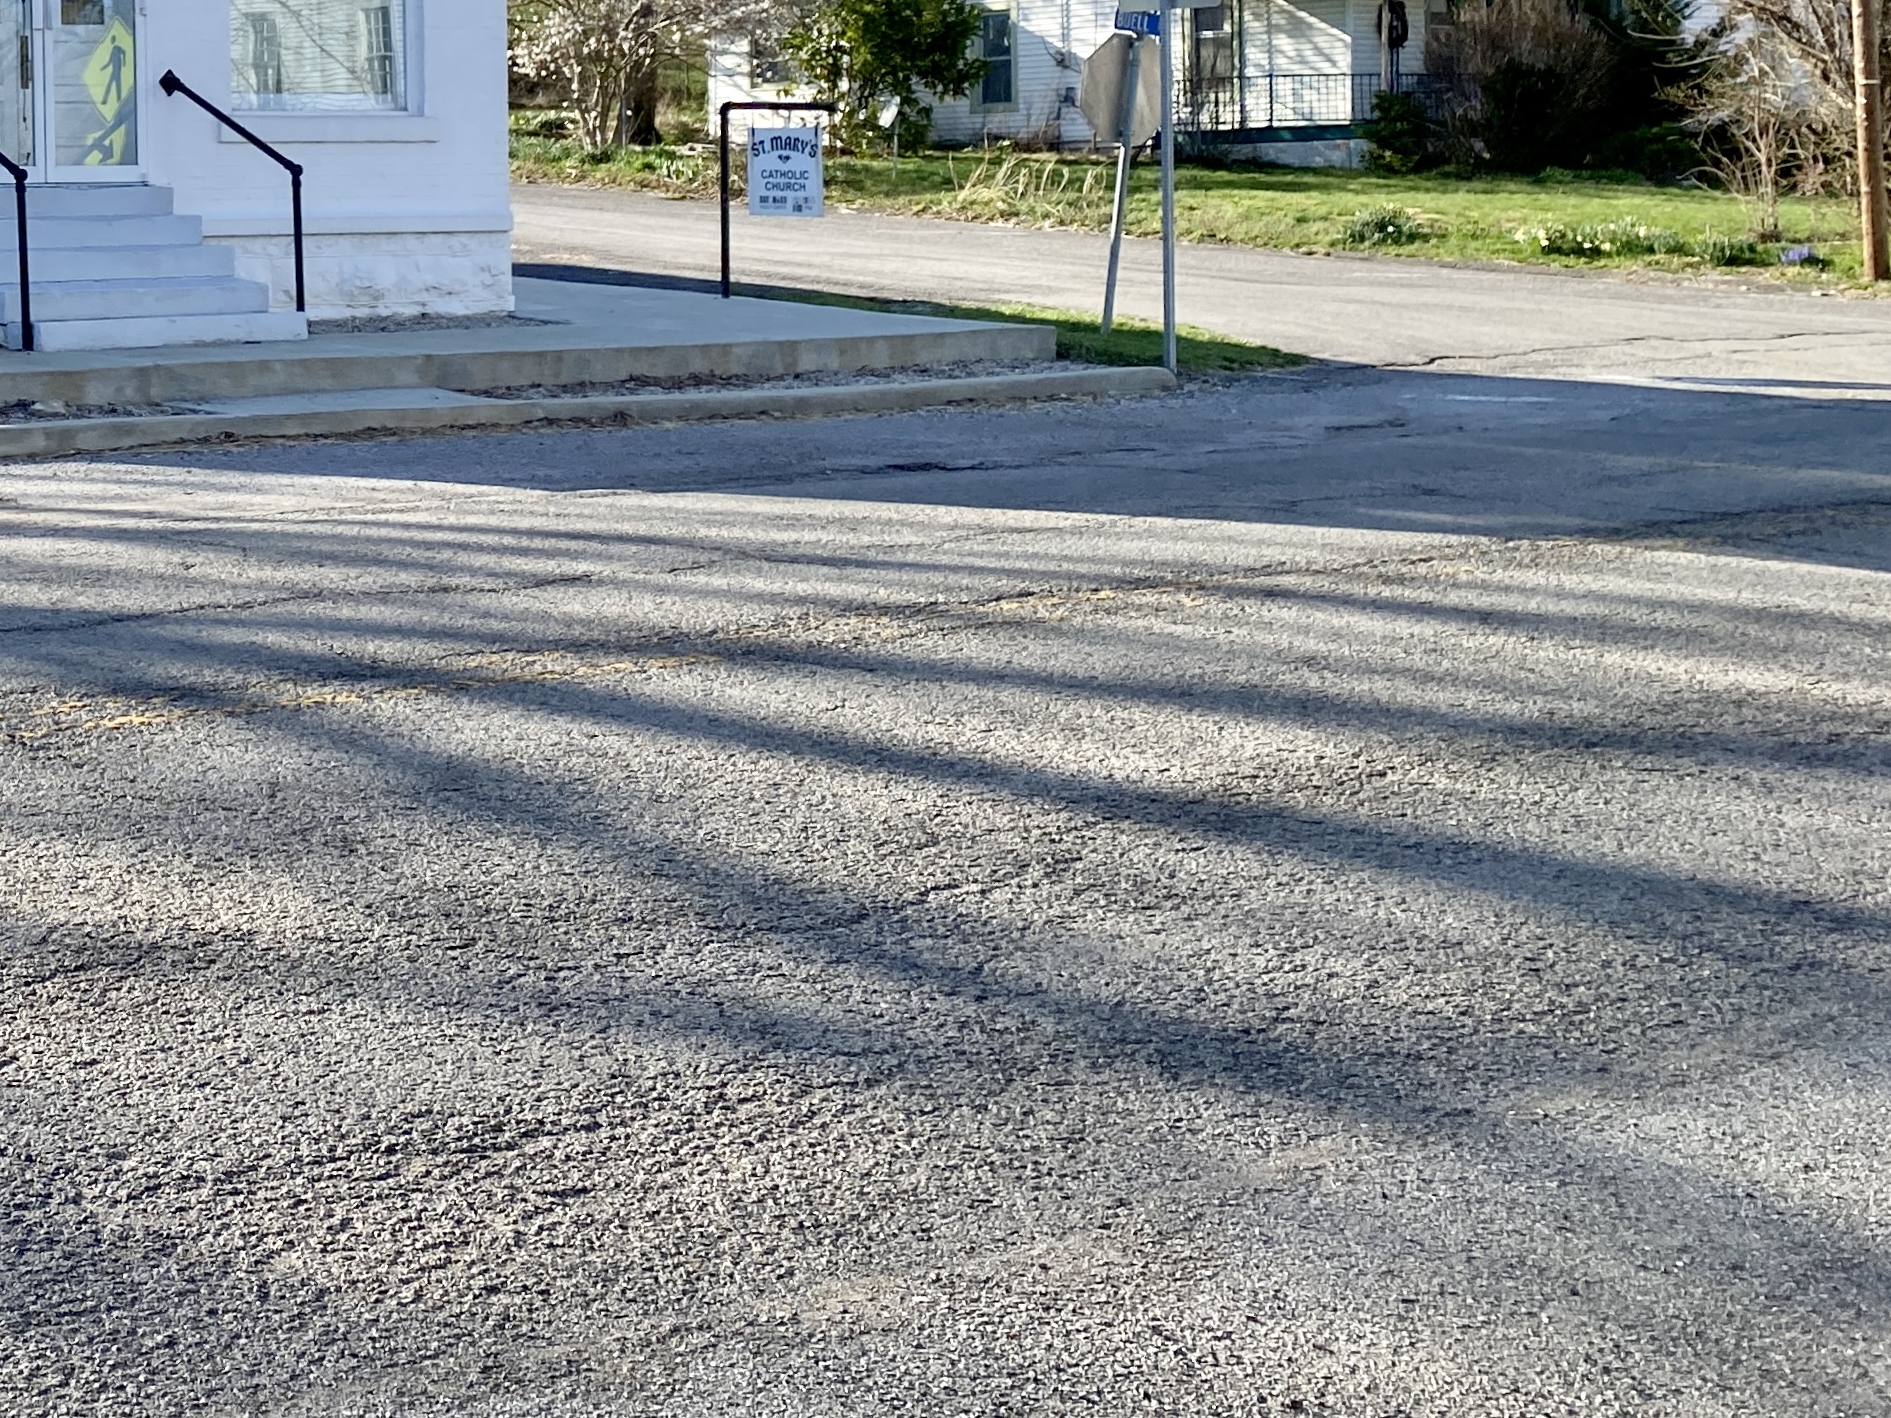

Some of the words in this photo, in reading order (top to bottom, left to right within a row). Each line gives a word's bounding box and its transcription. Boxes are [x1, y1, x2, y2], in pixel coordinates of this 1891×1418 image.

[1117, 13, 1149, 31] BUELL
[751, 139, 770, 157] ST.
[770, 135, 818, 158] MARY'S
[760, 169, 810, 180] CATHOLIC
[764, 181, 806, 192] CHURCH
